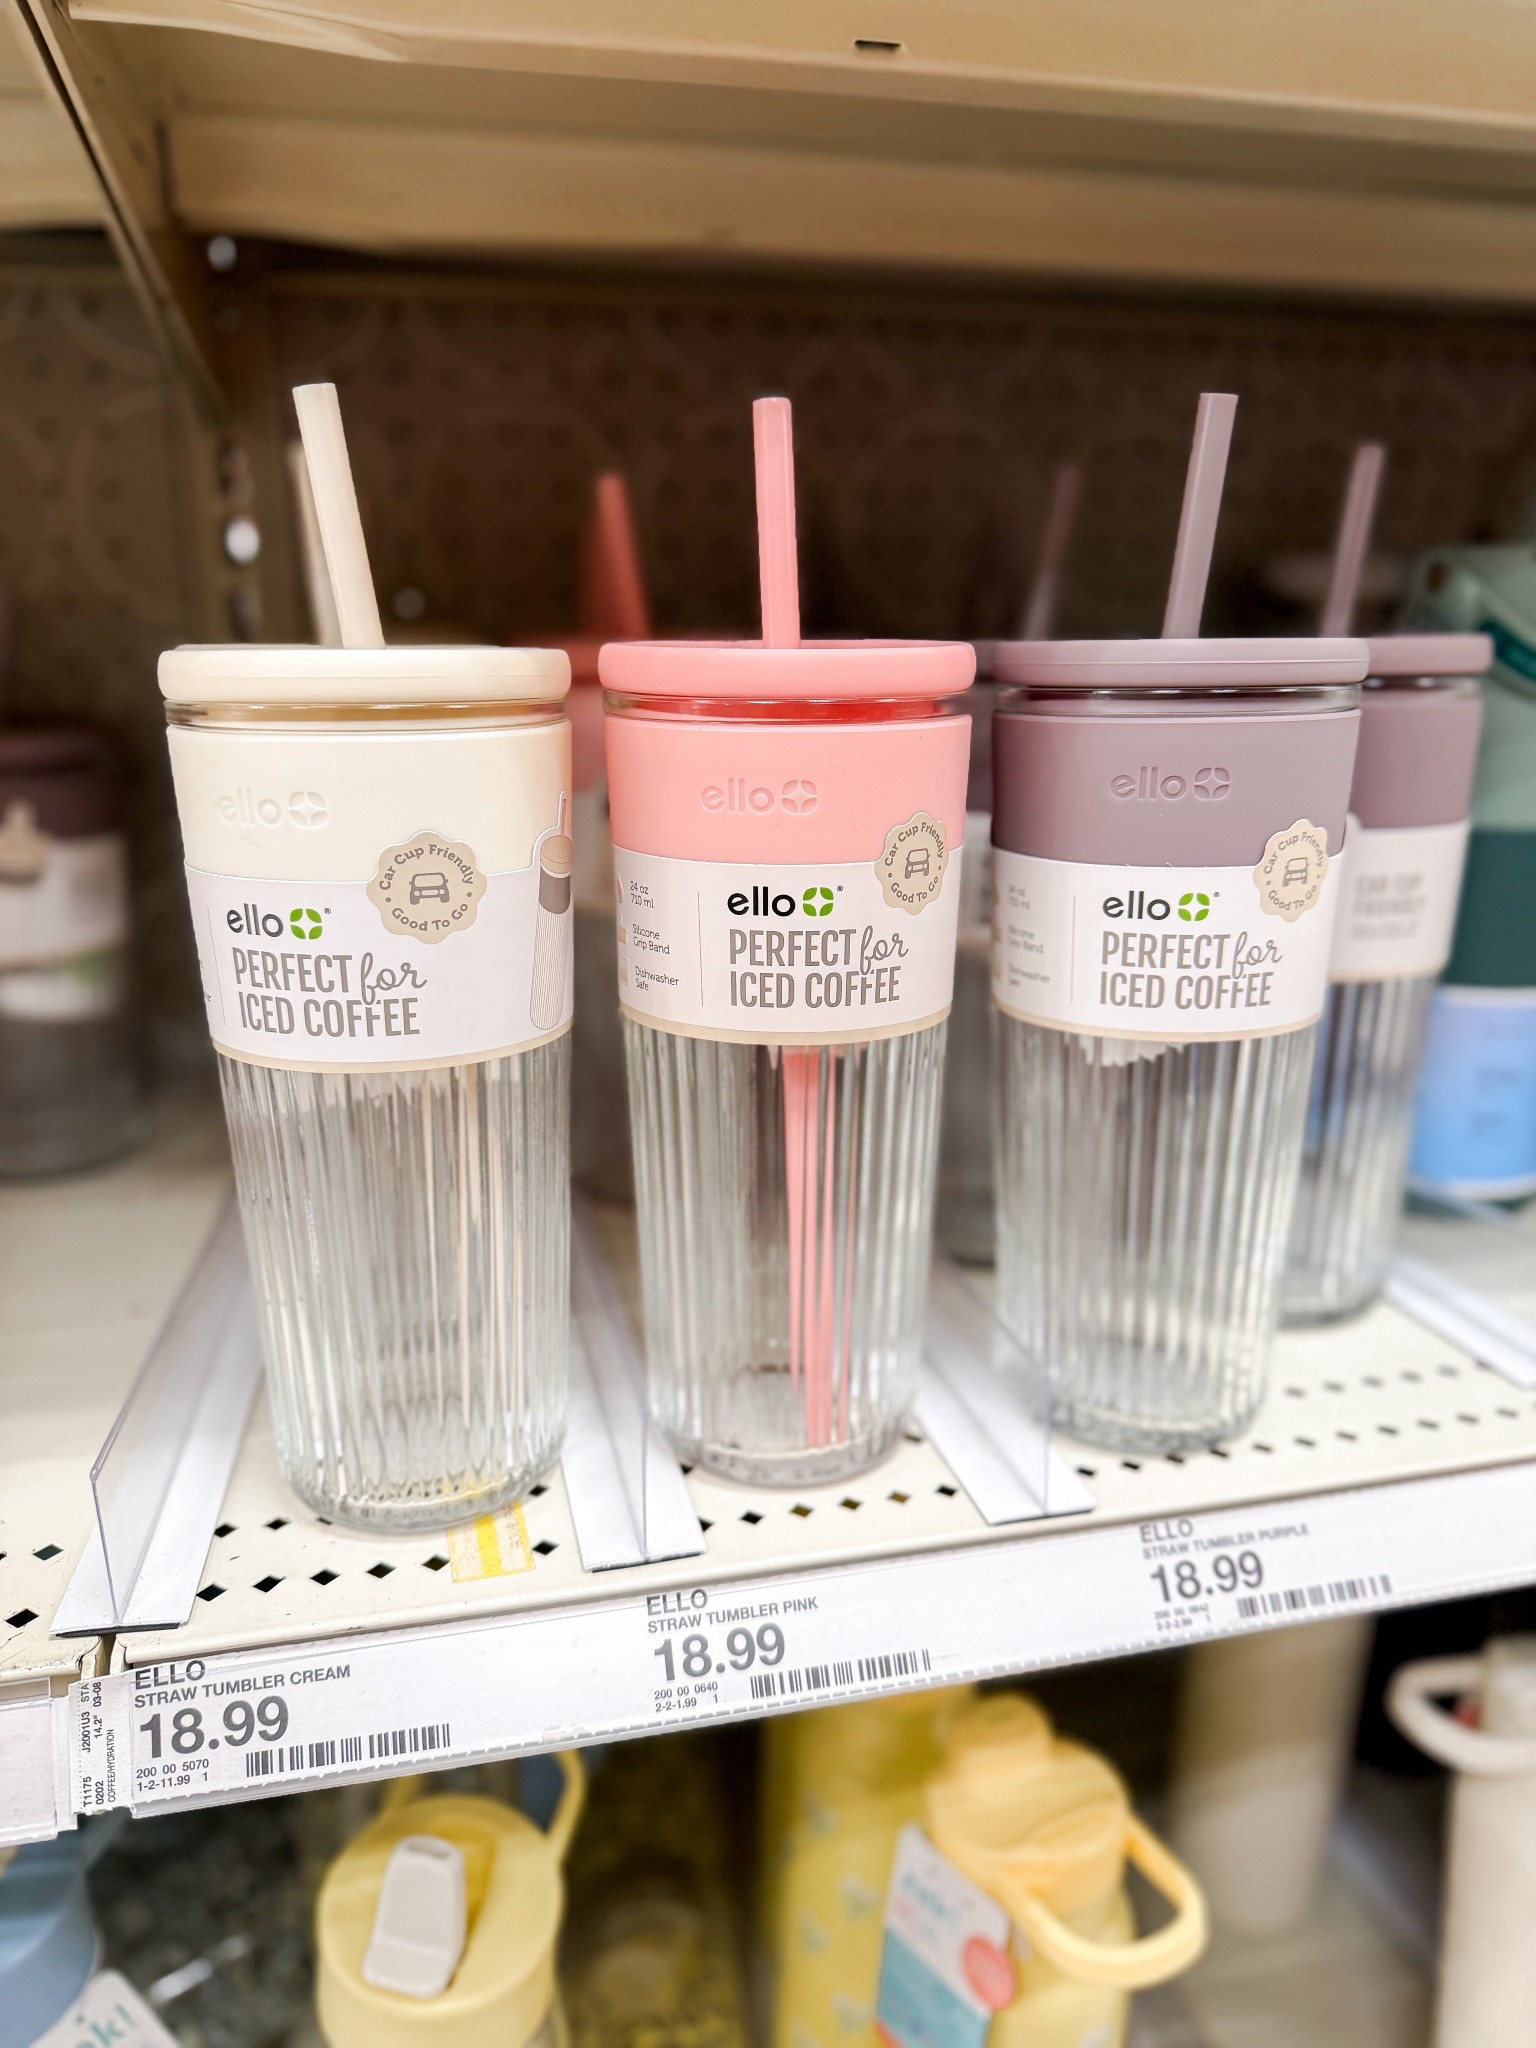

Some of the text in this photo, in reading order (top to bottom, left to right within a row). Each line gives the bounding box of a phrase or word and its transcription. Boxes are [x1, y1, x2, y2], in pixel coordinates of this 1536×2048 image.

[701, 778, 775, 814] ello
[1109, 766, 1187, 801] ello
[218, 787, 282, 828] ello
[885, 821, 945, 866] Car Cup Friendly
[1263, 831, 1324, 875] Car Cup Friendly
[379, 844, 474, 890] Car Cup Friendly
[630, 881, 649, 895] 24 oz
[631, 894, 655, 908] 710 ml
[727, 886, 796, 917] ello
[891, 876, 939, 903] Good To Go
[1102, 890, 1171, 921] ello
[1268, 885, 1317, 910] Good To Go
[226, 903, 284, 938] ello
[392, 904, 469, 931] Good To Go
[632, 924, 660, 940] Silicone
[633, 936, 670, 954] Grip Band
[729, 925, 909, 976] PERFECT for
[1101, 930, 1283, 980] PERFECT for
[232, 946, 353, 994] PERFECT
[359, 951, 428, 1005] for
[635, 965, 679, 986] Dishwasher
[635, 978, 649, 991] Safe
[729, 966, 901, 1009] ICED COFFEE
[1099, 971, 1274, 1010] ICED COFFEE
[238, 991, 421, 1038] ICED COFFEE
[1139, 1518, 1194, 1544] ELLO
[1142, 1524, 1308, 1560] STRAW TUMBLER PURPLE
[1150, 1550, 1264, 1602] 18.99
[646, 1588, 709, 1616] ELLO
[648, 1596, 819, 1634] STRAW TUMBLER PINK
[654, 1622, 786, 1681] 18.99
[134, 1664, 351, 1710] STRAW TUMBLER CREAM
[135, 1659, 206, 1690] ELLO
[654, 1688, 673, 1701] 200
[676, 1685, 690, 1697] 00
[655, 1694, 719, 1713] 2-2-1.99 1
[93, 1682, 104, 1805] 0202 14.2" 03-08
[139, 1695, 289, 1759] 18.99
[81, 1683, 93, 1807] T1175 J2001U3 STA
[106, 1729, 116, 1802] COFFEE/HYDRATION
[136, 1758, 209, 1779] 200 00 5070
[137, 1771, 208, 1792] 1-2-11.99 1
